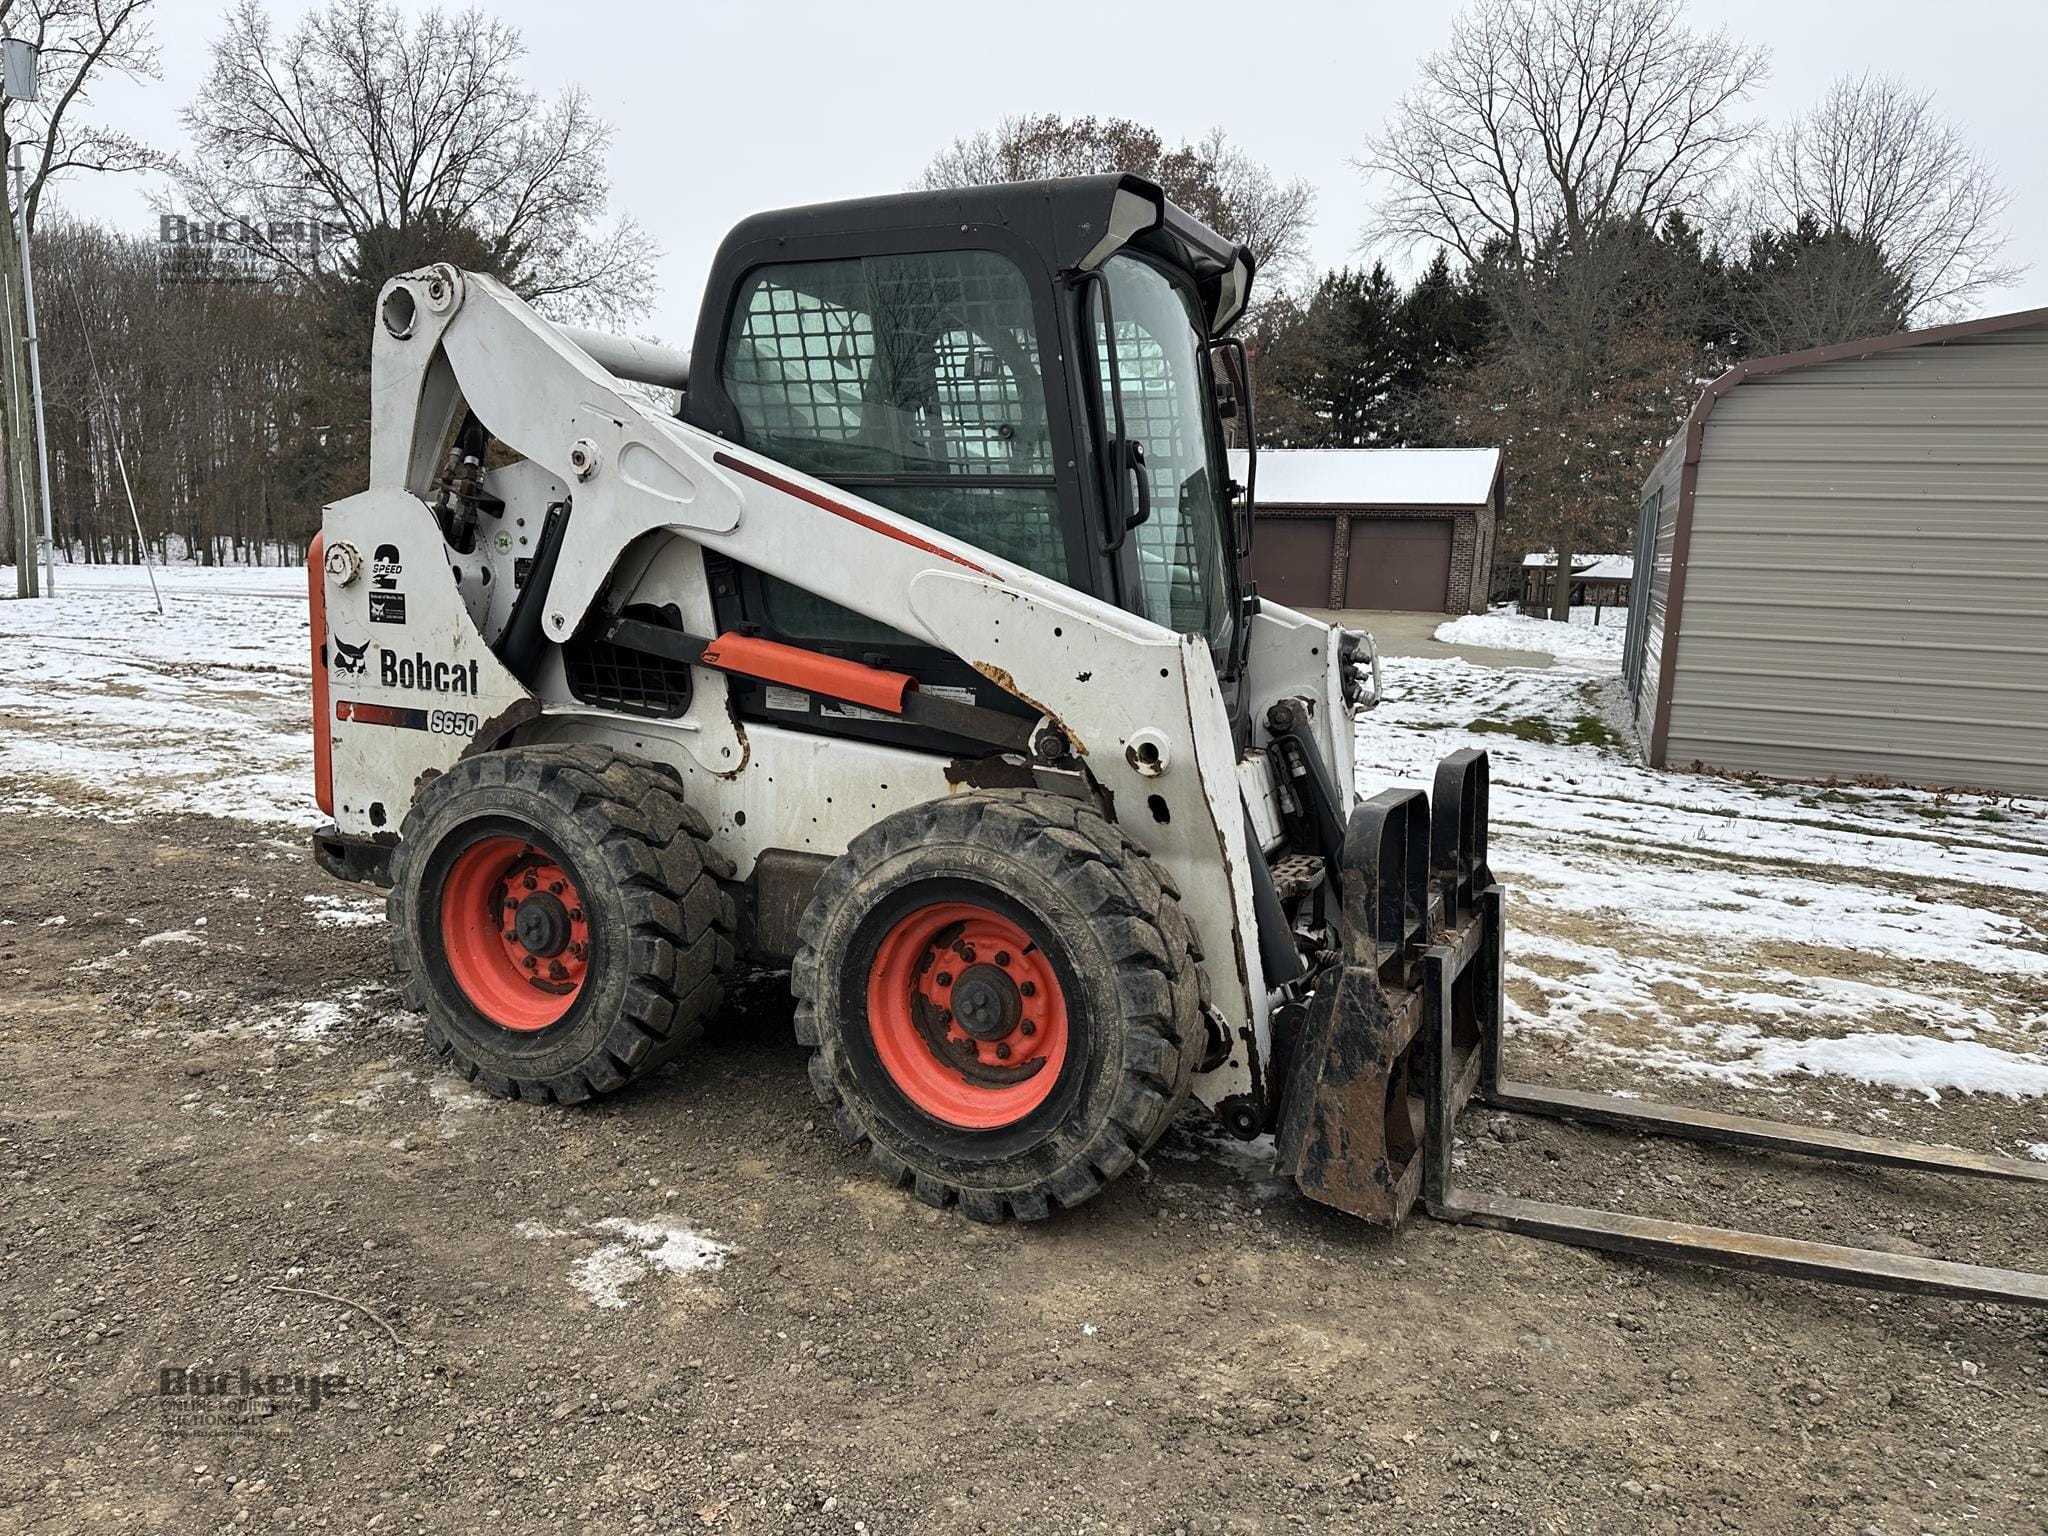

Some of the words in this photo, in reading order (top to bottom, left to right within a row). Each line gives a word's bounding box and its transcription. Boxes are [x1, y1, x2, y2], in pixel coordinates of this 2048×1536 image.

[373, 544, 400, 590] 2
[373, 563, 403, 574] SPEED
[380, 648, 479, 697] Bobcat
[431, 709, 479, 737] S650
